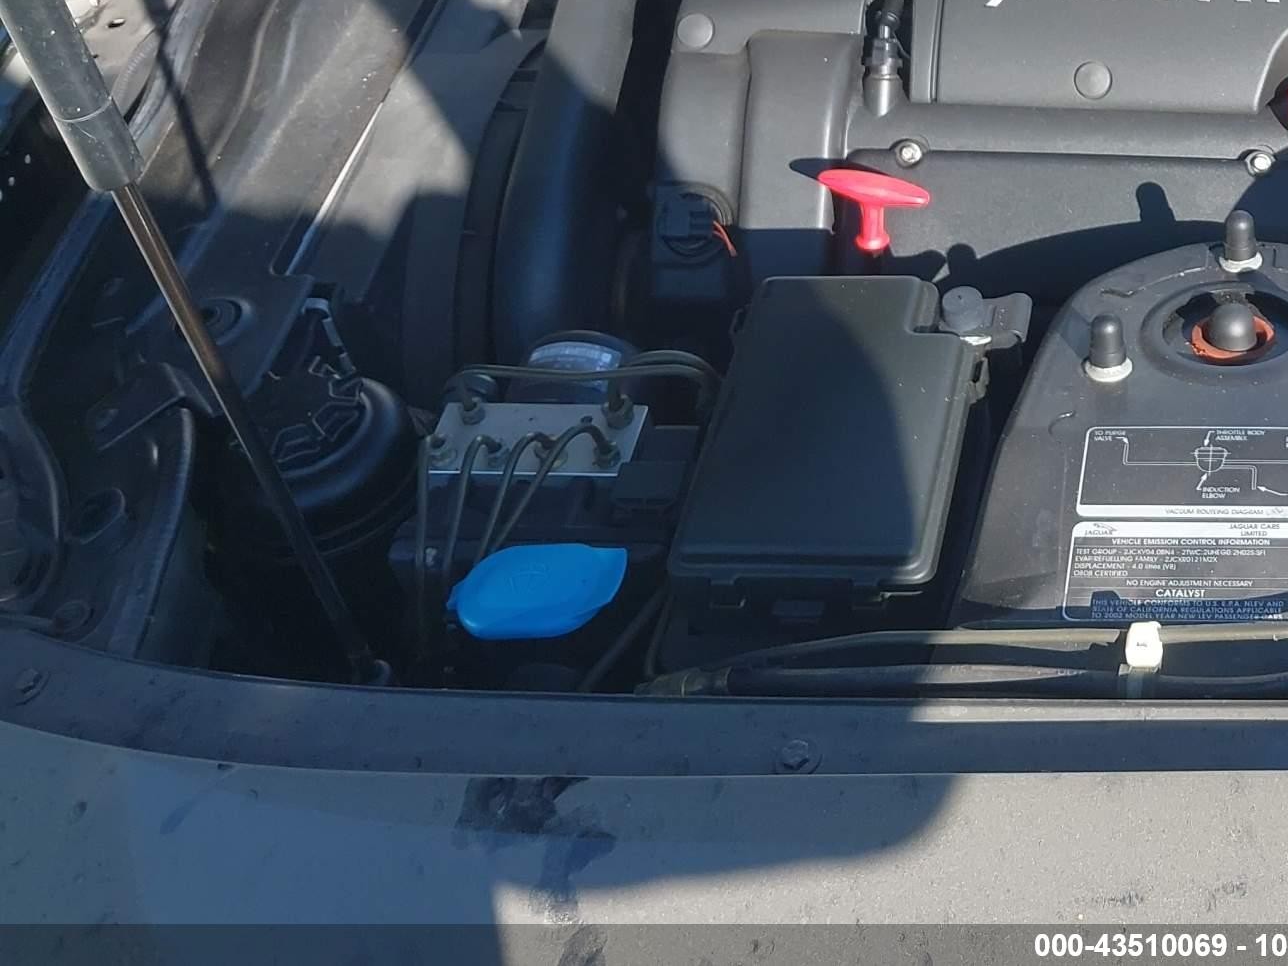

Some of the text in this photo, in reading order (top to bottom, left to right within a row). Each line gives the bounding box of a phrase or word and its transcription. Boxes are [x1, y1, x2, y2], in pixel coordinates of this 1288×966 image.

[1218, 538, 1271, 546] INFORMATION
[1155, 590, 1206, 598] CATALYST
[1144, 599, 1192, 607] CONFORMS
